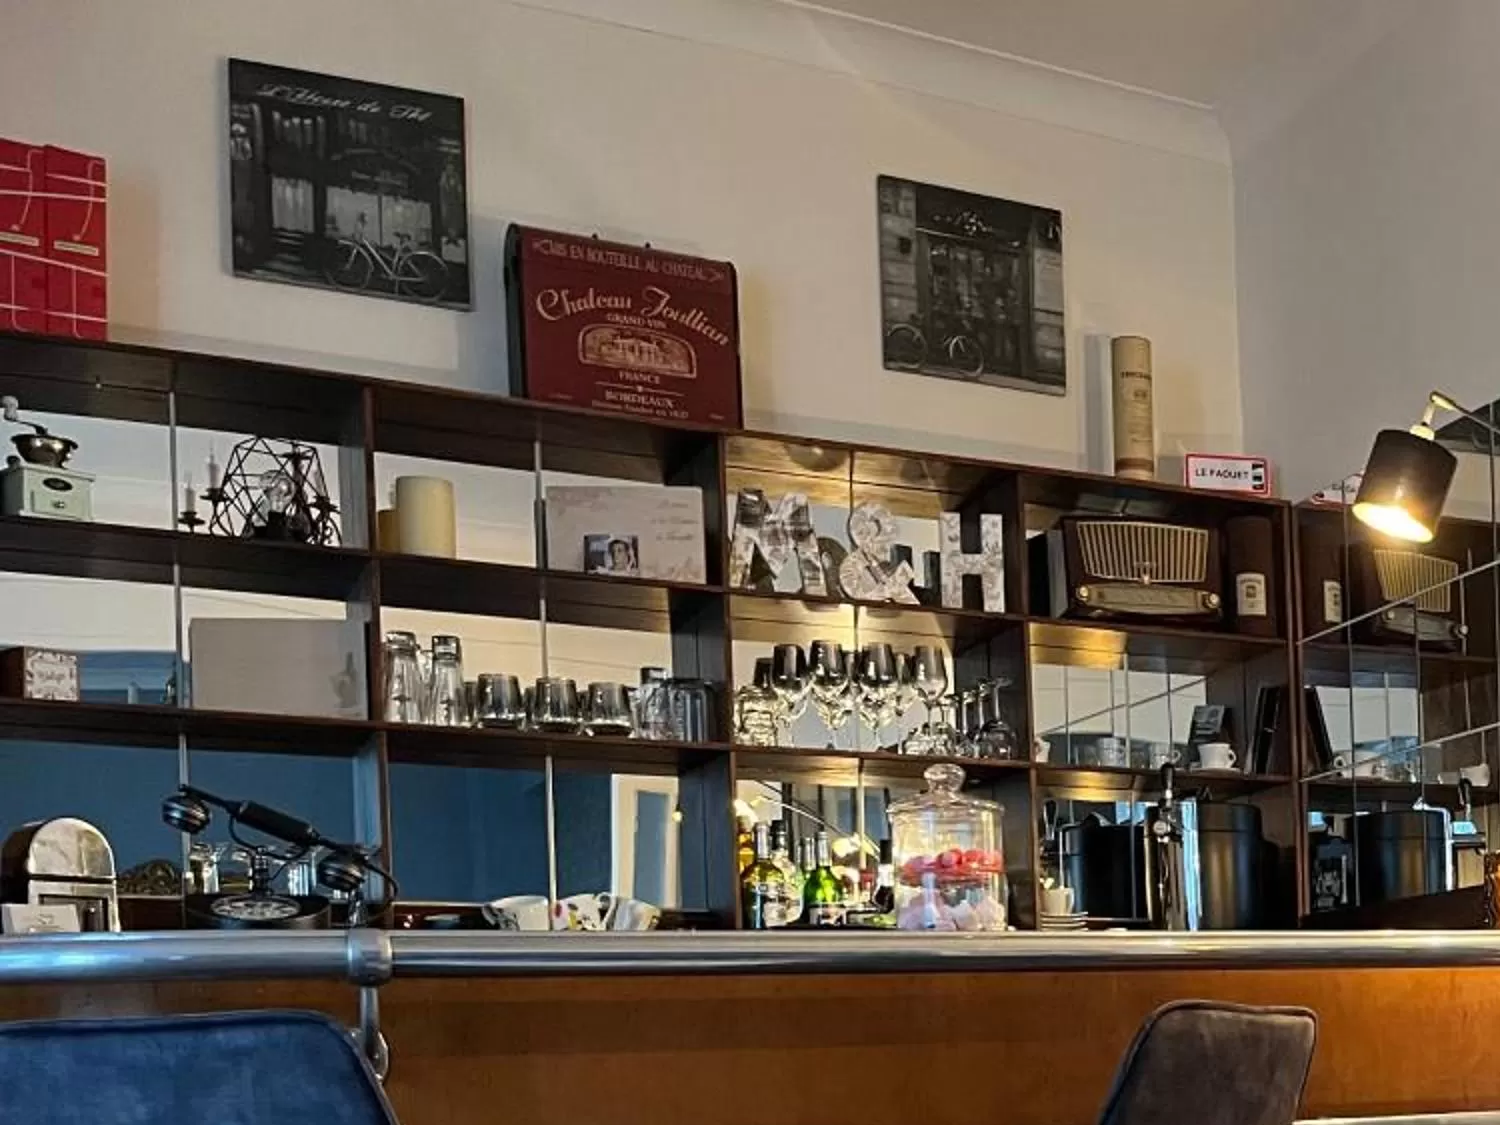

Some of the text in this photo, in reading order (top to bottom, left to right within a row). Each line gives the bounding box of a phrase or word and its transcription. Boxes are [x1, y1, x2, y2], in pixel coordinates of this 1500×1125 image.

[607, 313, 642, 326] GRAND
[618, 371, 661, 385] FRANCE
[604, 390, 675, 409] BORDEAUX
